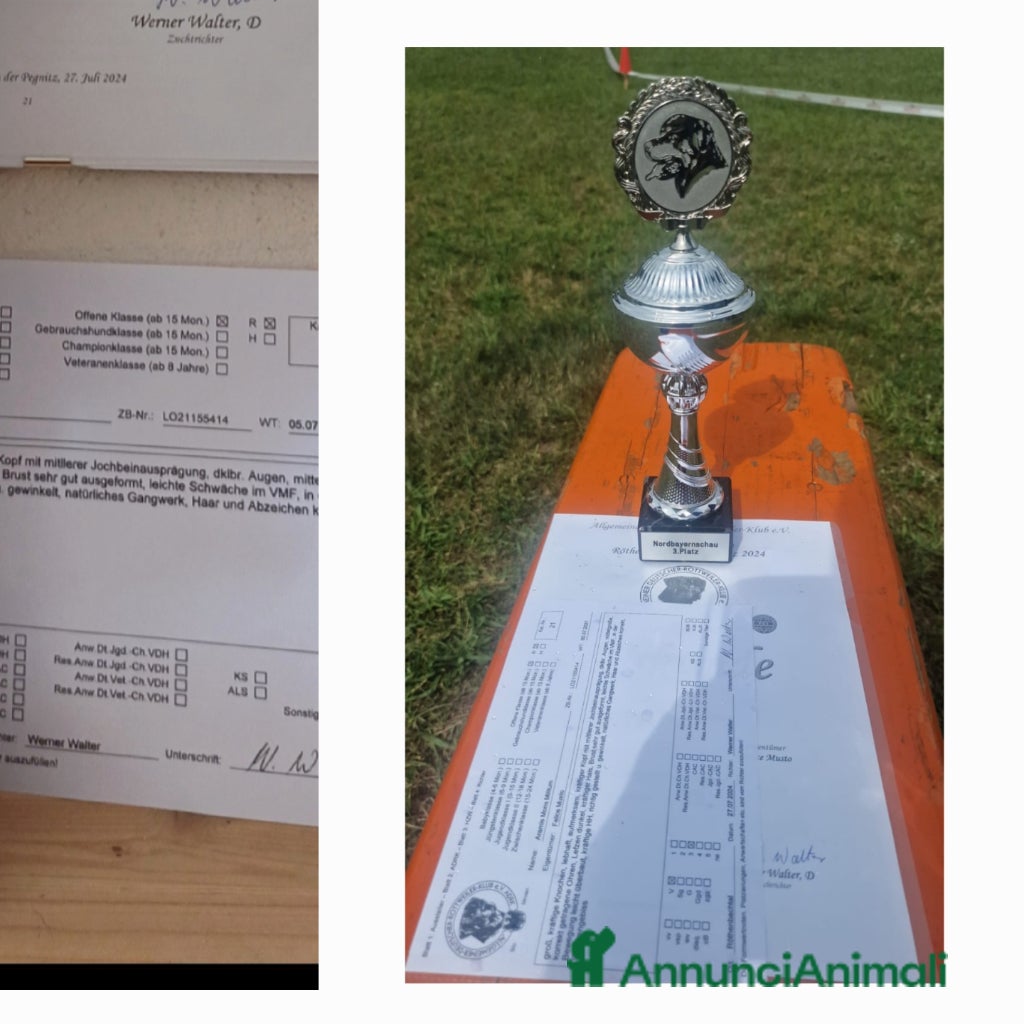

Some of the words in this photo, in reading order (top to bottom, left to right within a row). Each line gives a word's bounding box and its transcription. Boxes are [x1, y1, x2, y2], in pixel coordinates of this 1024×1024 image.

[131, 14, 185, 28] Werner
[188, 13, 241, 31] Walter,
[247, 15, 262, 29] D
[167, 34, 224, 45] Zuchtrichter
[3, 71, 19, 82] der
[64, 73, 78, 83] 27.
[80, 72, 100, 84] Juli
[102, 73, 127, 83] 2024
[75, 310, 108, 323] Offene
[110, 311, 143, 324] Klasse
[147, 313, 163, 325] (ab
[166, 314, 178, 324] 15
[248, 318, 256, 327] R
[35, 323, 143, 339] Gebrauchshundklasse
[248, 334, 256, 343] H
[62, 340, 143, 355] Championklasse
[64, 356, 146, 370] Veteranenklasse
[177, 362, 209, 375] Jahre)
[163, 411, 229, 425] LO21155414
[25, 456, 41, 467] mit
[248, 471, 289, 486] Augen,
[2, 469, 31, 481] Brust
[34, 472, 56, 483] sehr
[61, 473, 79, 485] gut
[81, 475, 145, 490] ausgeformt,
[149, 479, 185, 491] leichte
[189, 481, 248, 495] Schwäche
[252, 485, 266, 497] im
[269, 487, 301, 500] VMF,
[304, 489, 314, 500] in
[8, 484, 61, 499] gewinkelt,
[65, 489, 124, 503] natürliches
[128, 492, 187, 507] Gangwerk,
[192, 497, 220, 509] Haar
[223, 500, 244, 511] und
[248, 502, 309, 516] Abzeichen
[653, 540, 719, 549] Nordbayernschau
[742, 550, 766, 558] 2024
[234, 672, 248, 682] KS
[228, 686, 248, 697] ALS
[27, 733, 64, 749] Werner
[68, 737, 101, 751] Walter
